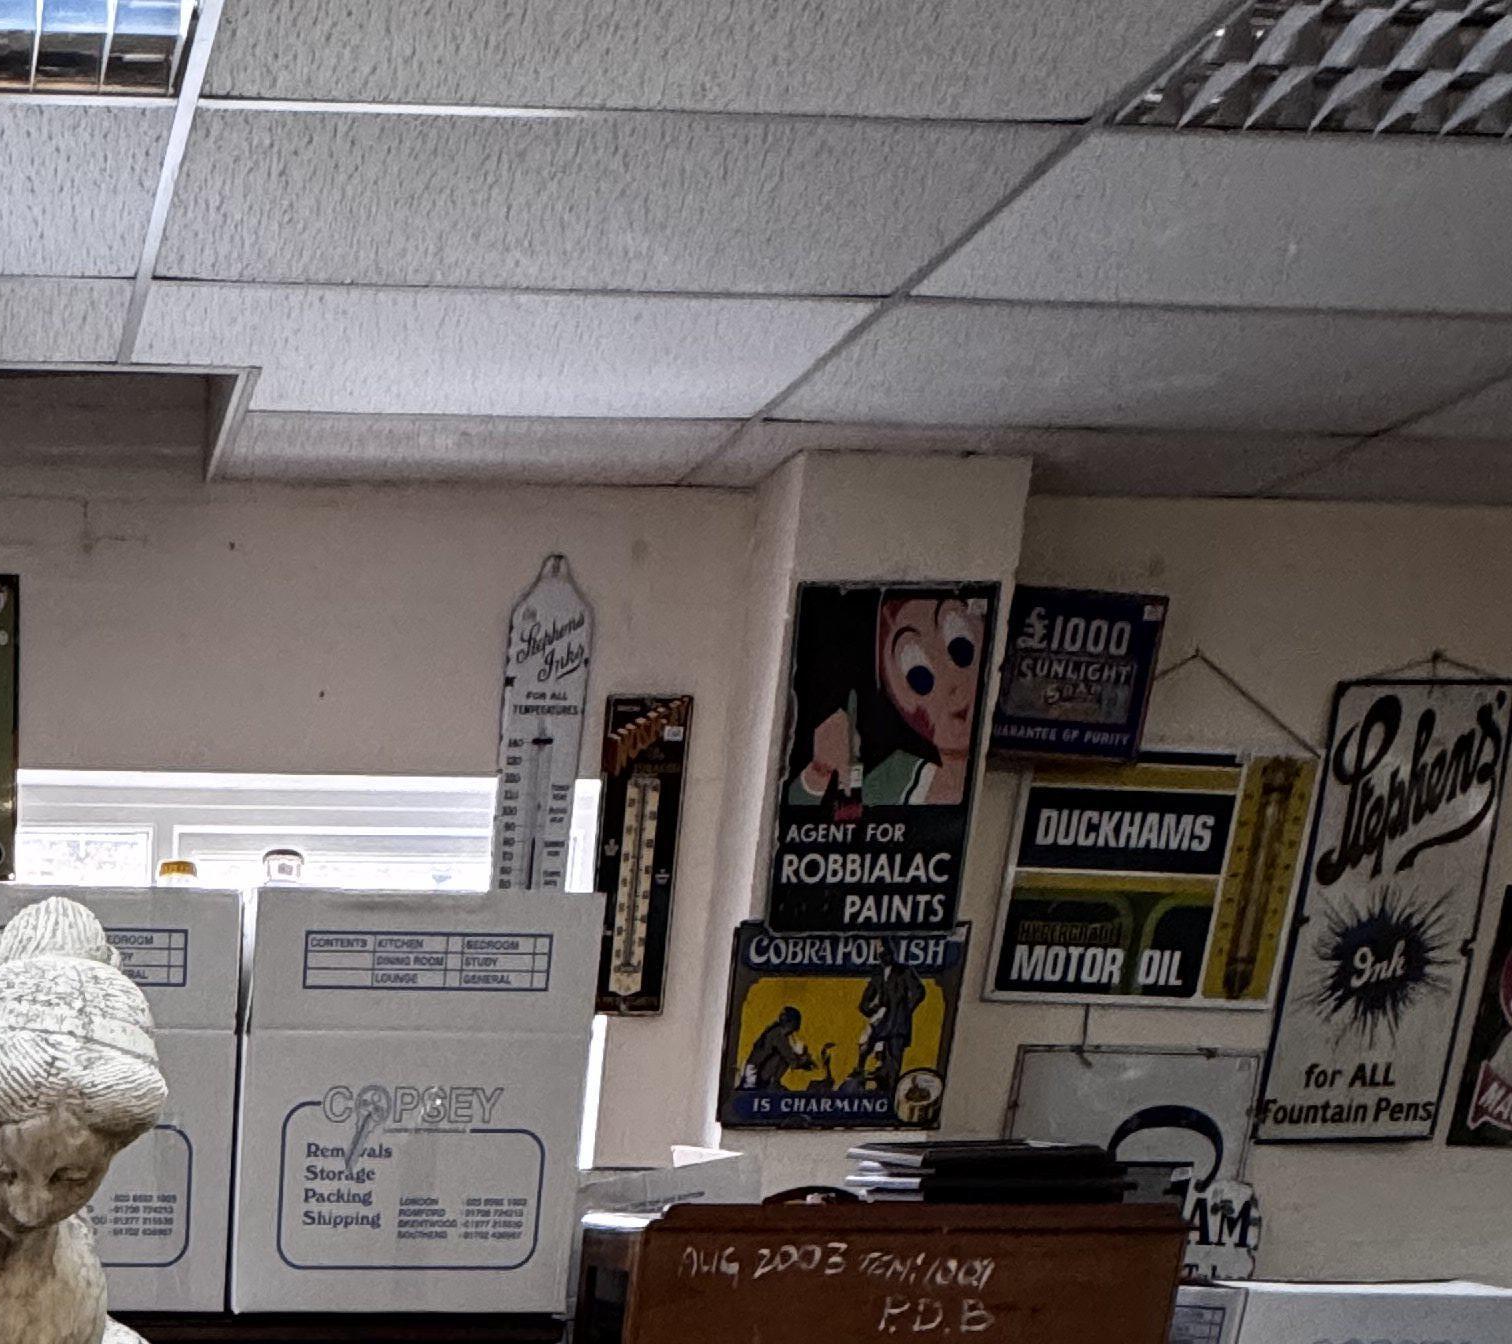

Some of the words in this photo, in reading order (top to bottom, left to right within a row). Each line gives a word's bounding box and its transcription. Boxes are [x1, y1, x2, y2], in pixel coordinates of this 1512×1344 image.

[1016, 606, 1131, 656] £1000
[537, 642, 585, 682] Inks
[1020, 657, 1131, 685] SUNLIGHT
[1084, 729, 1131, 746] PURITY
[787, 823, 857, 843] AGENT
[865, 823, 906, 842] FOR
[1035, 808, 1216, 851] DUCKHAMS
[780, 852, 952, 884] ROBBIALAC
[843, 895, 946, 924] PAINTS
[106, 935, 154, 945] EDROOM
[310, 937, 368, 949] CONTENTS
[377, 938, 425, 950] KITCHEN
[749, 935, 833, 965] COBRA
[413, 955, 445, 967] ROOM
[464, 957, 498, 967] STUDY
[1009, 944, 1125, 985] MOTOR
[1138, 949, 1183, 986] OIL
[1350, 944, 1407, 988] Ink
[374, 973, 419, 985] LOUNGE
[462, 974, 512, 985] GENERAL
[1304, 1064, 1342, 1090] for
[1348, 1062, 1396, 1089] ALL
[323, 1084, 505, 1124] COPSEY
[752, 1097, 771, 1113] IS
[780, 1097, 889, 1114] CHARMING
[1262, 1098, 1368, 1126] Fountain
[1373, 1097, 1434, 1124] Pens
[304, 1164, 376, 1183] Storage
[303, 1188, 373, 1207] Packing
[302, 1210, 381, 1229] Shipping
[679, 1246, 740, 1287] AUG
[752, 1242, 848, 1279] 2003
